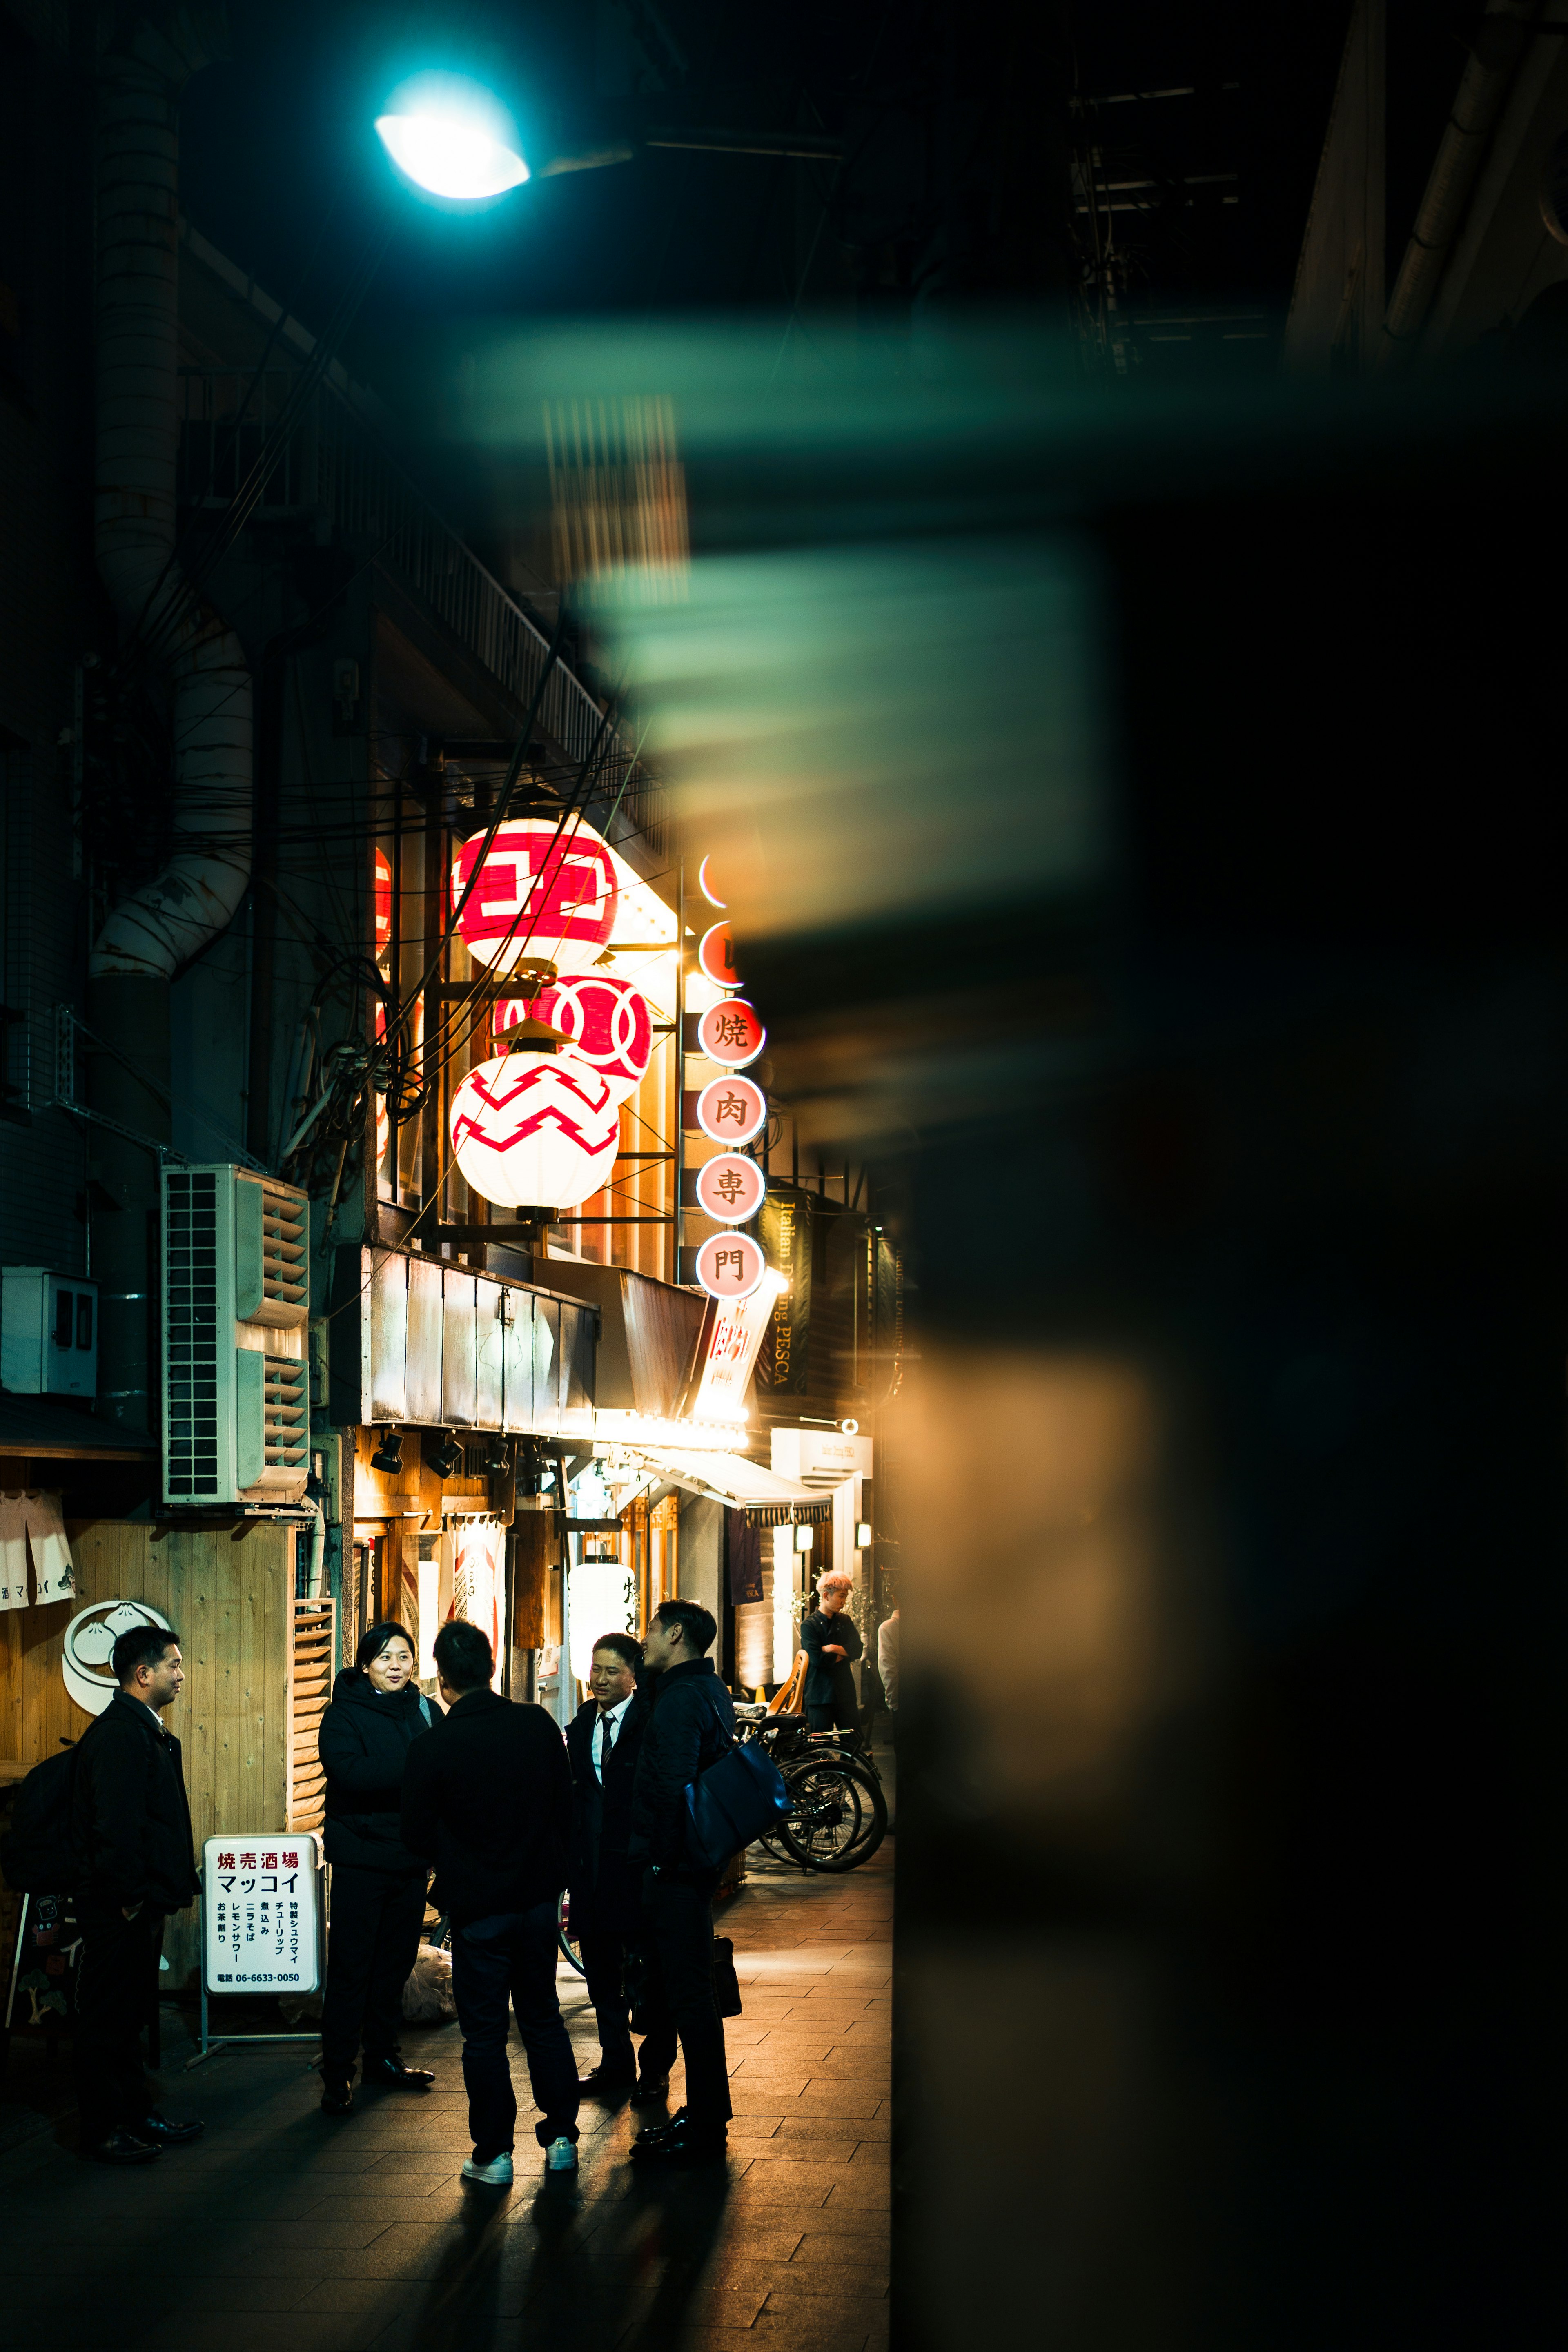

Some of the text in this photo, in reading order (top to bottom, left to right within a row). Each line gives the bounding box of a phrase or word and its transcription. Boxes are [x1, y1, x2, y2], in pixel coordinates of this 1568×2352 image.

[713, 1014, 748, 1281] 焼肉専門
[774, 1203, 796, 1386] Italian Ding PESCA
[16, 1580, 49, 1597] マコイ
[218, 1852, 299, 1869] 焼売酒場
[218, 1873, 299, 1894] マッコイ
[217, 1903, 225, 1943] お茶割り
[232, 1903, 241, 1962] レモンサワー
[246, 1903, 255, 1941] ニラそば
[261, 1902, 269, 1935] 煮込み
[275, 1902, 284, 1955] チューリップ
[290, 1902, 298, 1964] 特製シュウマイ
[217, 1973, 299, 1982] 電話 06-6633-0050
